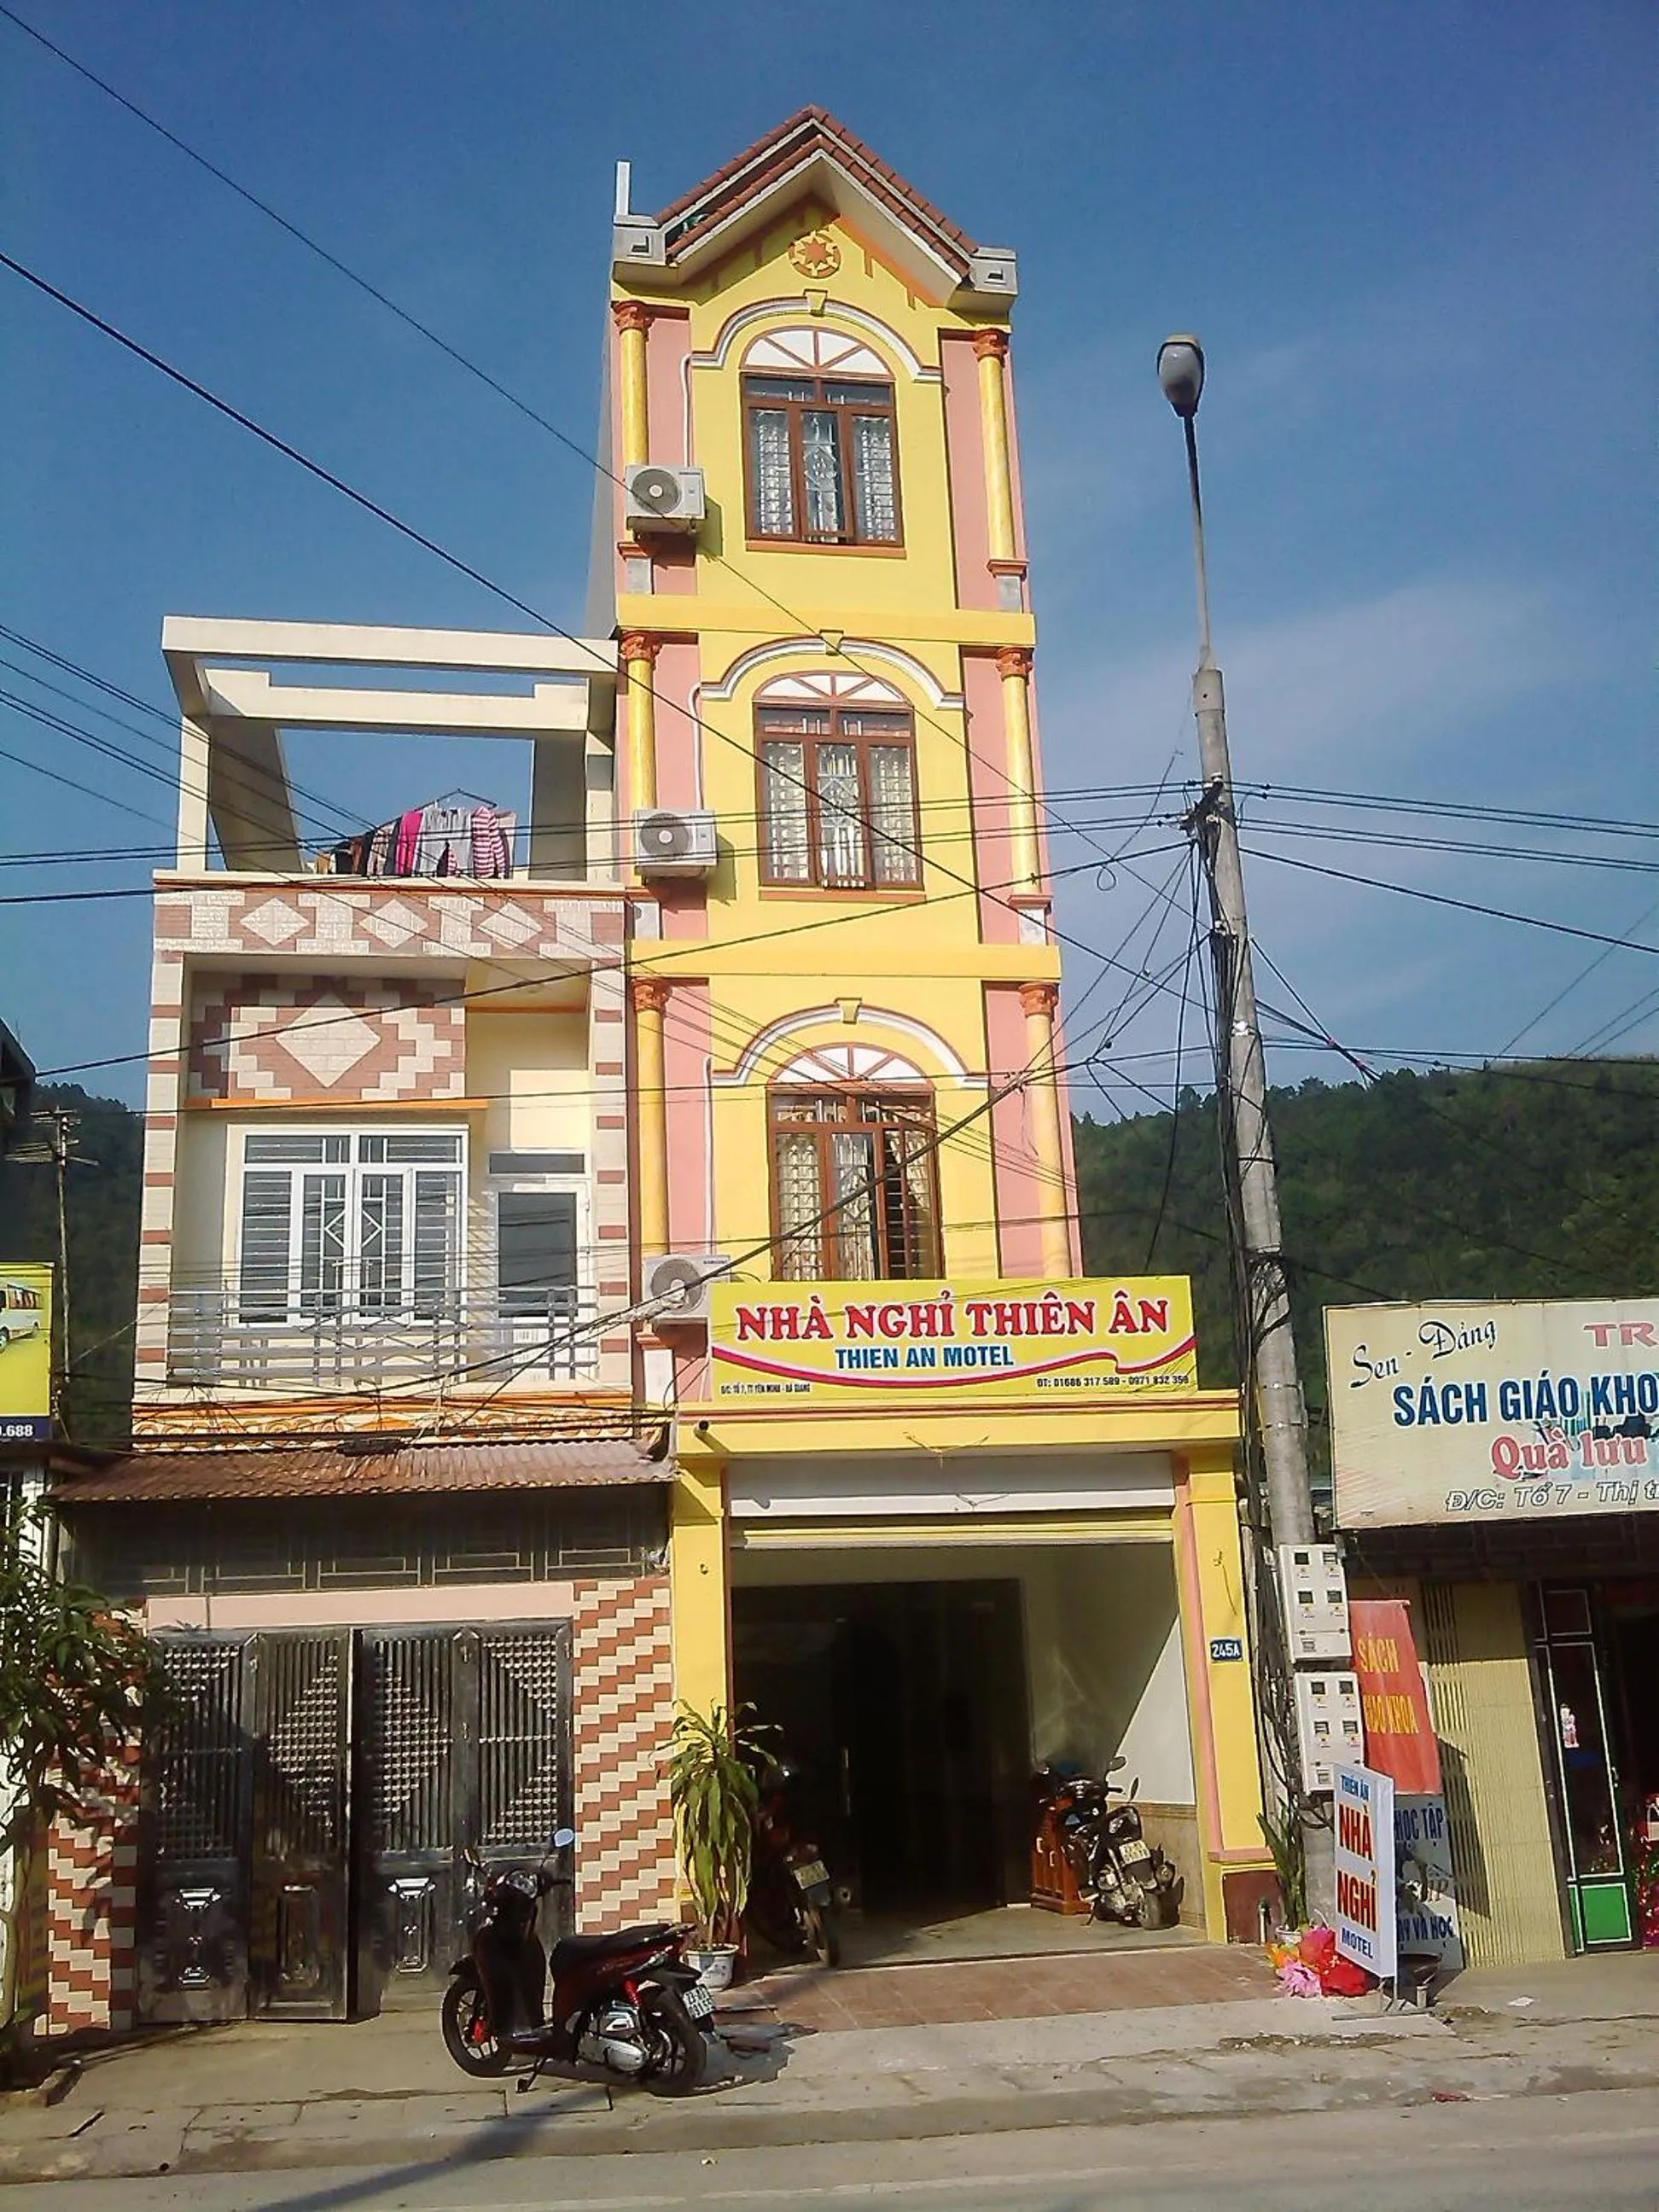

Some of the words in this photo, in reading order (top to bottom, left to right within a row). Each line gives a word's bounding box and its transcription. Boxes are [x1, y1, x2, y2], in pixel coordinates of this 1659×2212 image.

[736, 1295, 833, 1340] NHÀ
[845, 1290, 955, 1338] NGHỈ
[966, 1291, 1095, 1336] THIÊN
[1109, 1289, 1168, 1334] ÂN
[835, 1346, 899, 1369] THIEN
[905, 1347, 934, 1368] AN
[943, 1345, 1014, 1367] MOTEL
[1349, 1344, 1400, 1388] Sen
[1393, 1376, 1487, 1426] SÁCH
[1499, 1370, 1579, 1421] GIÁO
[0, 1423, 33, 1437] .688
[1556, 1485, 1572, 1505] 7
[1212, 1642, 1241, 1658] 245A
[1339, 1803, 1374, 1862] NHÀ
[1337, 1869, 1377, 1932] NGHỈ
[1342, 1926, 1374, 1959] MOTEL
